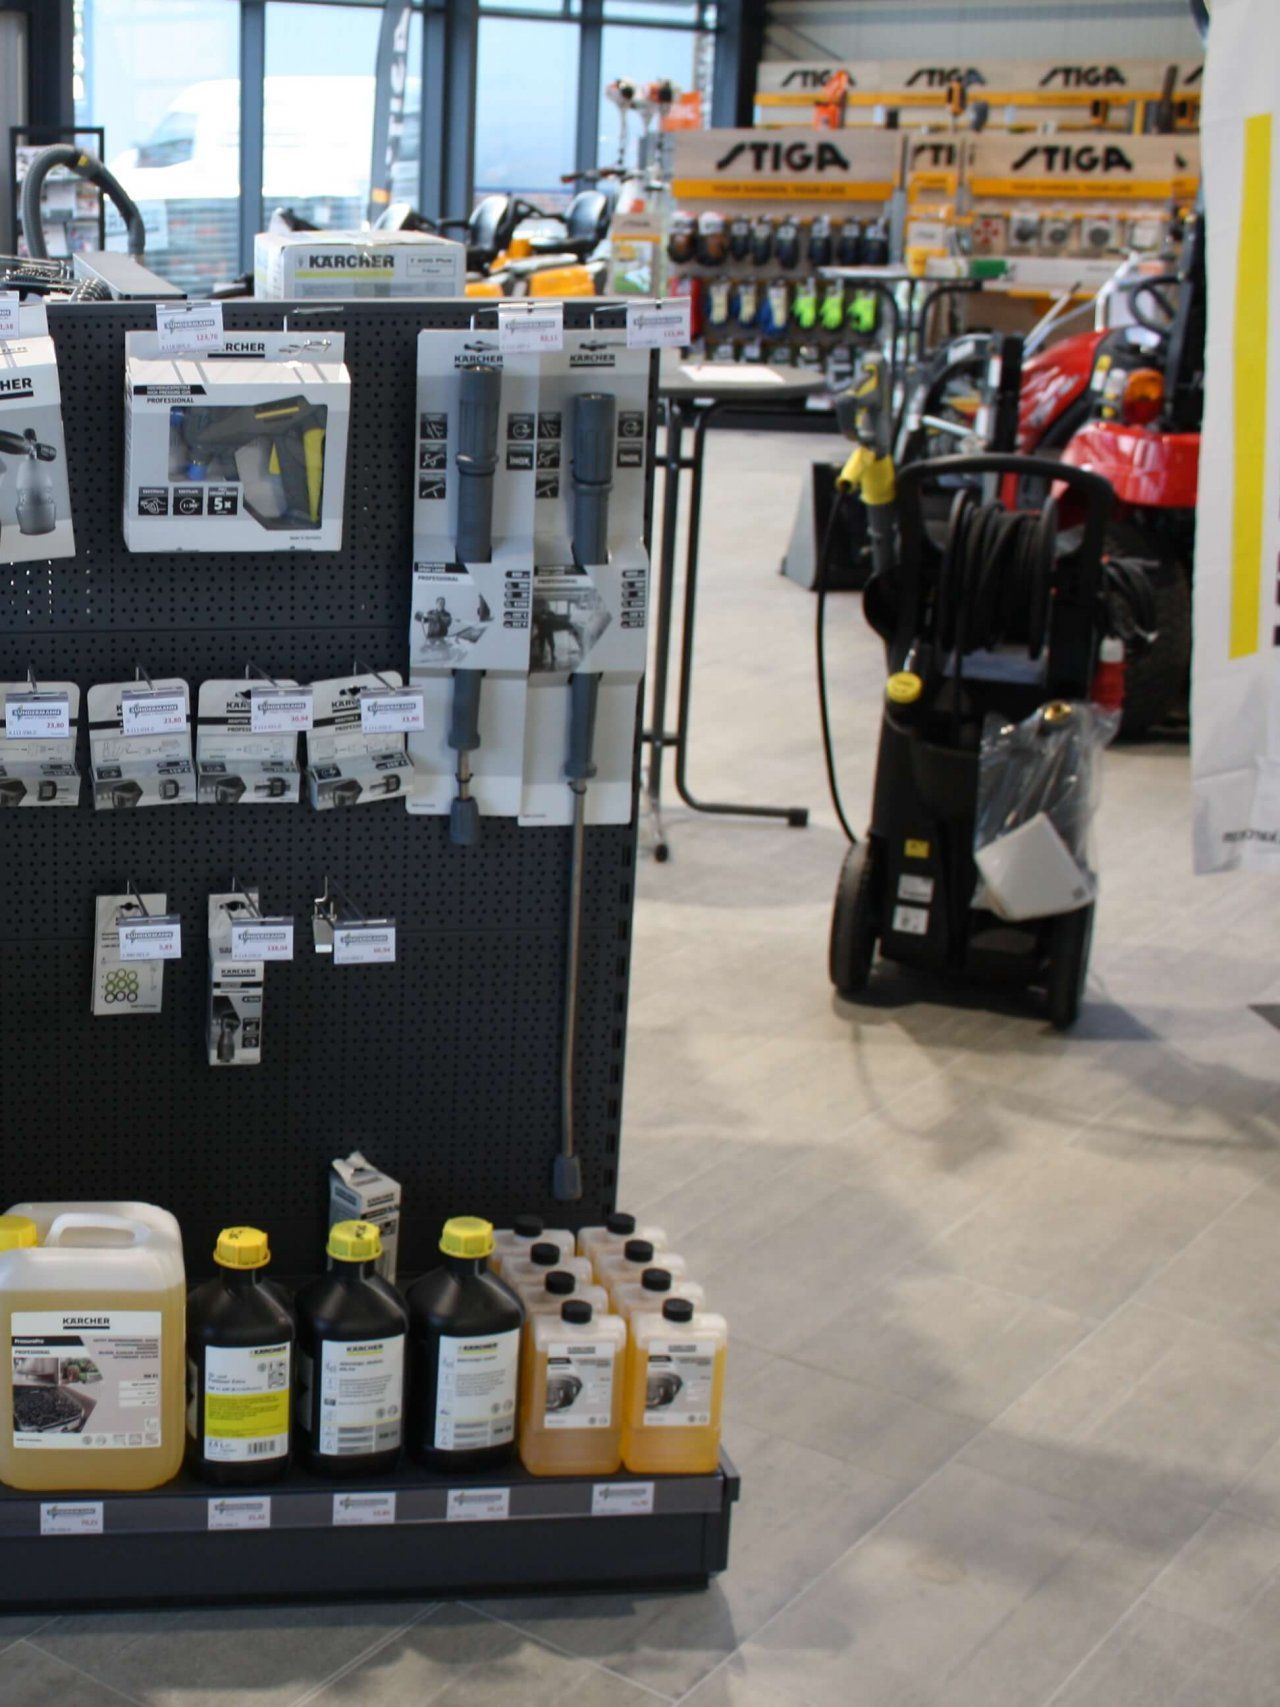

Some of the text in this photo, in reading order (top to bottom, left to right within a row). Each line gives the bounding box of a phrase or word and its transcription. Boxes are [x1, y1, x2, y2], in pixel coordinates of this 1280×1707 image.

[1040, 66, 1126, 86] STIGA
[716, 142, 850, 171] STIGA
[1011, 145, 1133, 172] STIGA
[309, 254, 395, 269] KÄRCHER
[222, 342, 266, 352] RCHER
[454, 354, 503, 364] KÄRCHER
[569, 354, 616, 363] KÄRCHER
[62, 1316, 111, 1325] KÄRCHER
